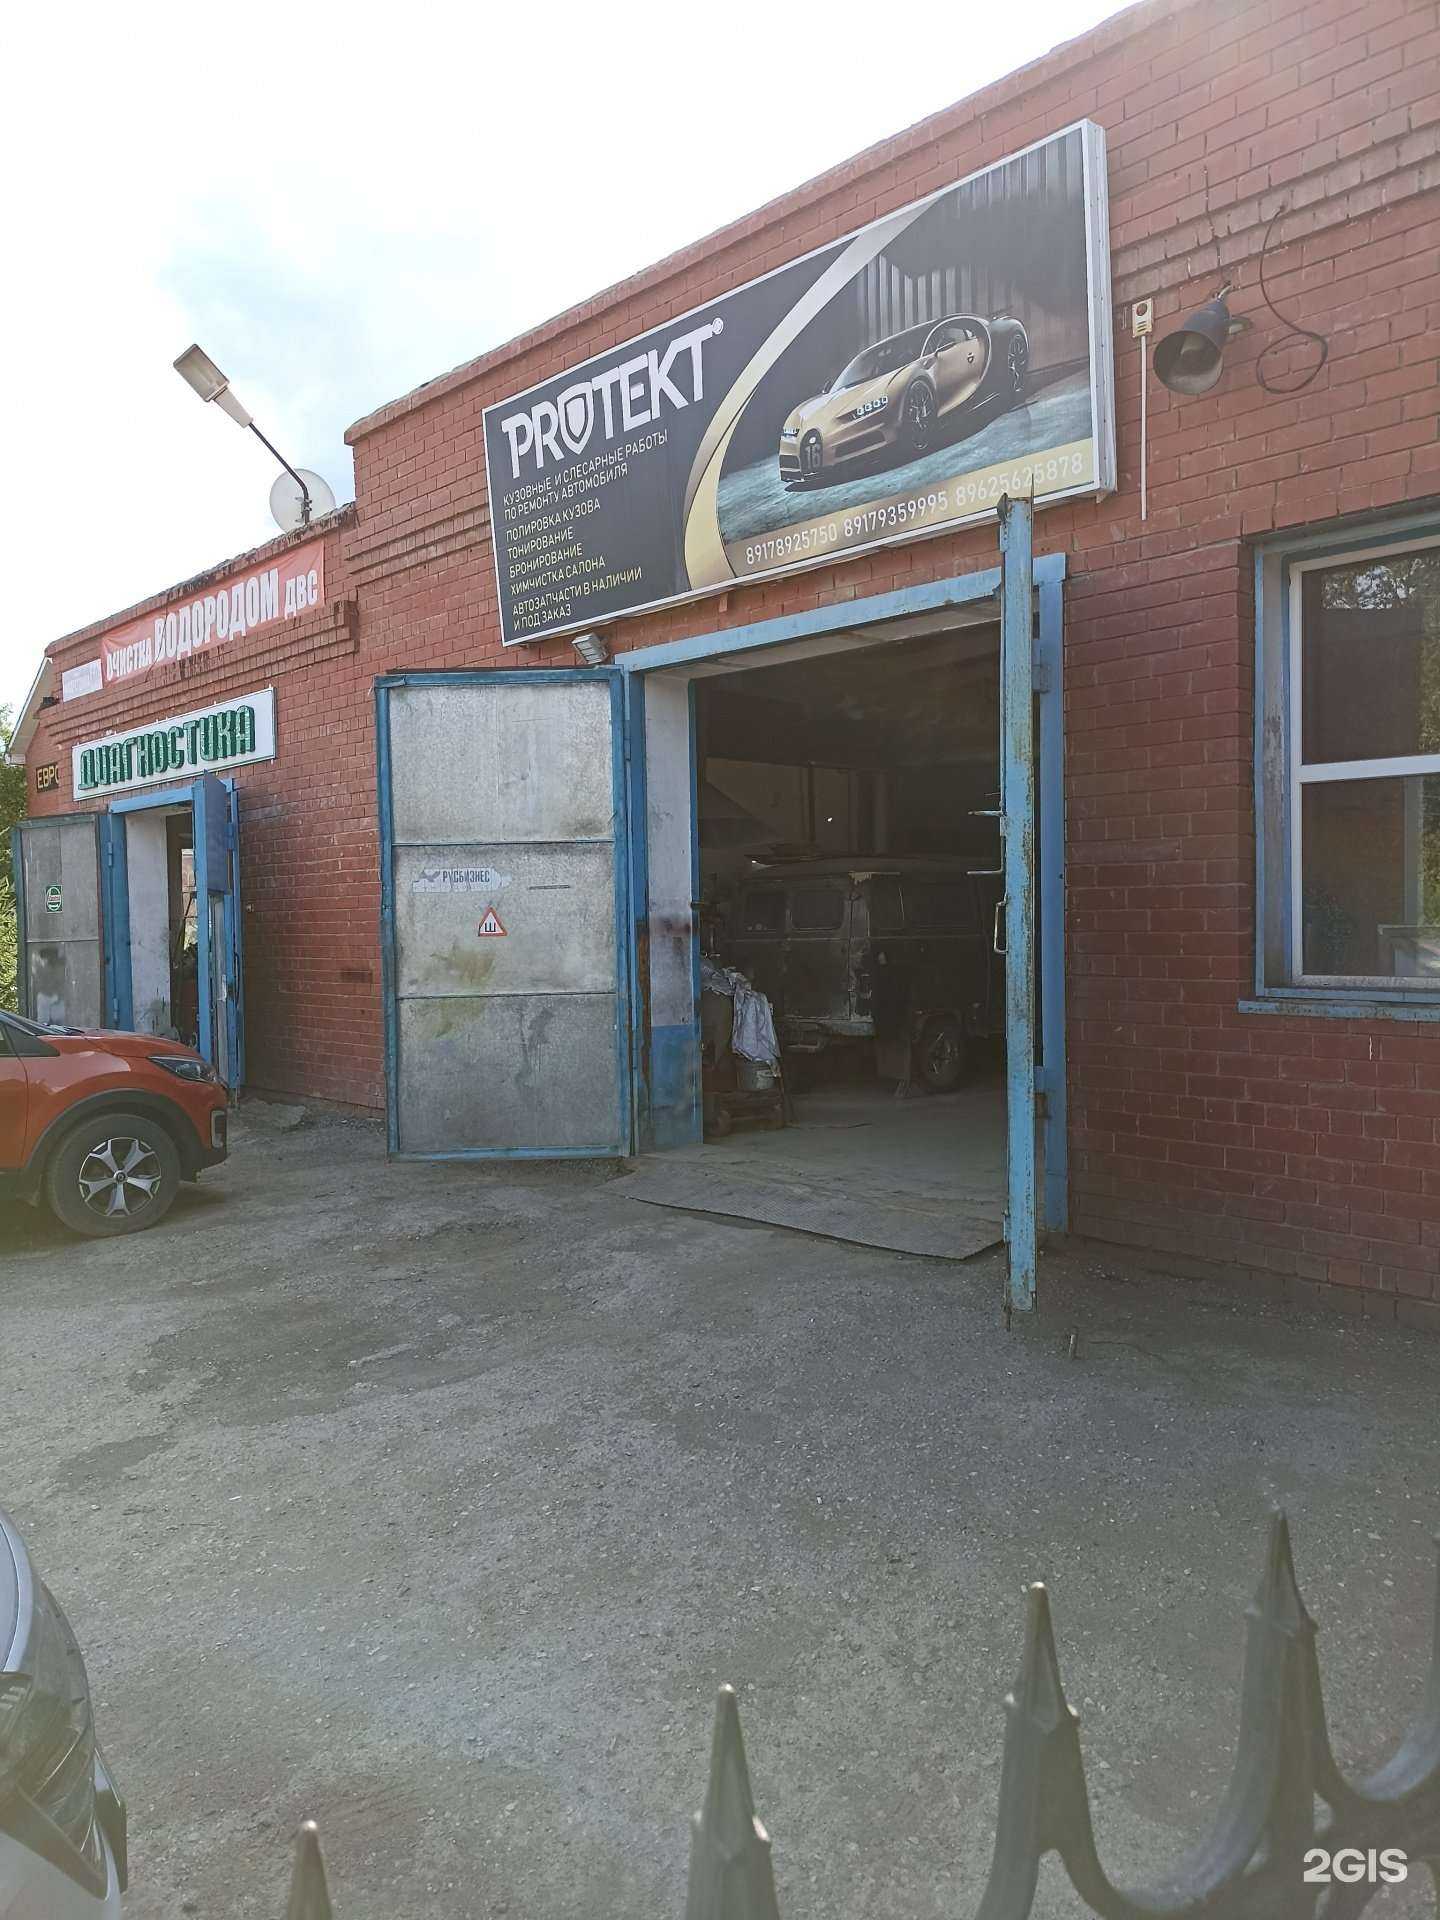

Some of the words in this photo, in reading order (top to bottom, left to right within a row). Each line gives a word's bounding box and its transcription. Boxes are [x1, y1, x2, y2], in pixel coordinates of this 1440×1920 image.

[503, 477, 552, 507] КУЗОВНЫЕ
[554, 473, 562, 486] И
[563, 447, 624, 483] СЛЕСАРНЫЕ
[625, 429, 668, 458] РАБОТЫ
[504, 507, 518, 521] ПО
[518, 492, 559, 516] РЕМОНТУ
[561, 463, 628, 500] АВТОМОБИЛЯ
[506, 513, 561, 542] ПОЛИРОВКА
[562, 498, 601, 521] КУЗОВА
[745, 523, 838, 565] 89178925750
[843, 491, 949, 537] 89179359995
[956, 452, 1083, 507] 89625625878
[507, 526, 574, 560] ТОНИРОВАНИЕ
[509, 543, 583, 579] БРОНИРОВАНИЕ
[511, 571, 564, 596] ХИМЧИСТКА
[565, 555, 606, 579] САЛОНА
[512, 584, 582, 616] АВТОЗАПЧАСТИ
[584, 582, 591, 595] В
[592, 566, 642, 593] НАЛИЧИИ
[106, 637, 152, 681] ОЧИСТКА
[153, 567, 279, 660] ВОДОРОДОМ
[284, 570, 318, 620] ДВС
[513, 619, 520, 631] И
[521, 613, 541, 629] ПОД
[541, 603, 572, 624] ЗАКАЗ
[78, 704, 256, 791] ДИАГНОСТИКА
